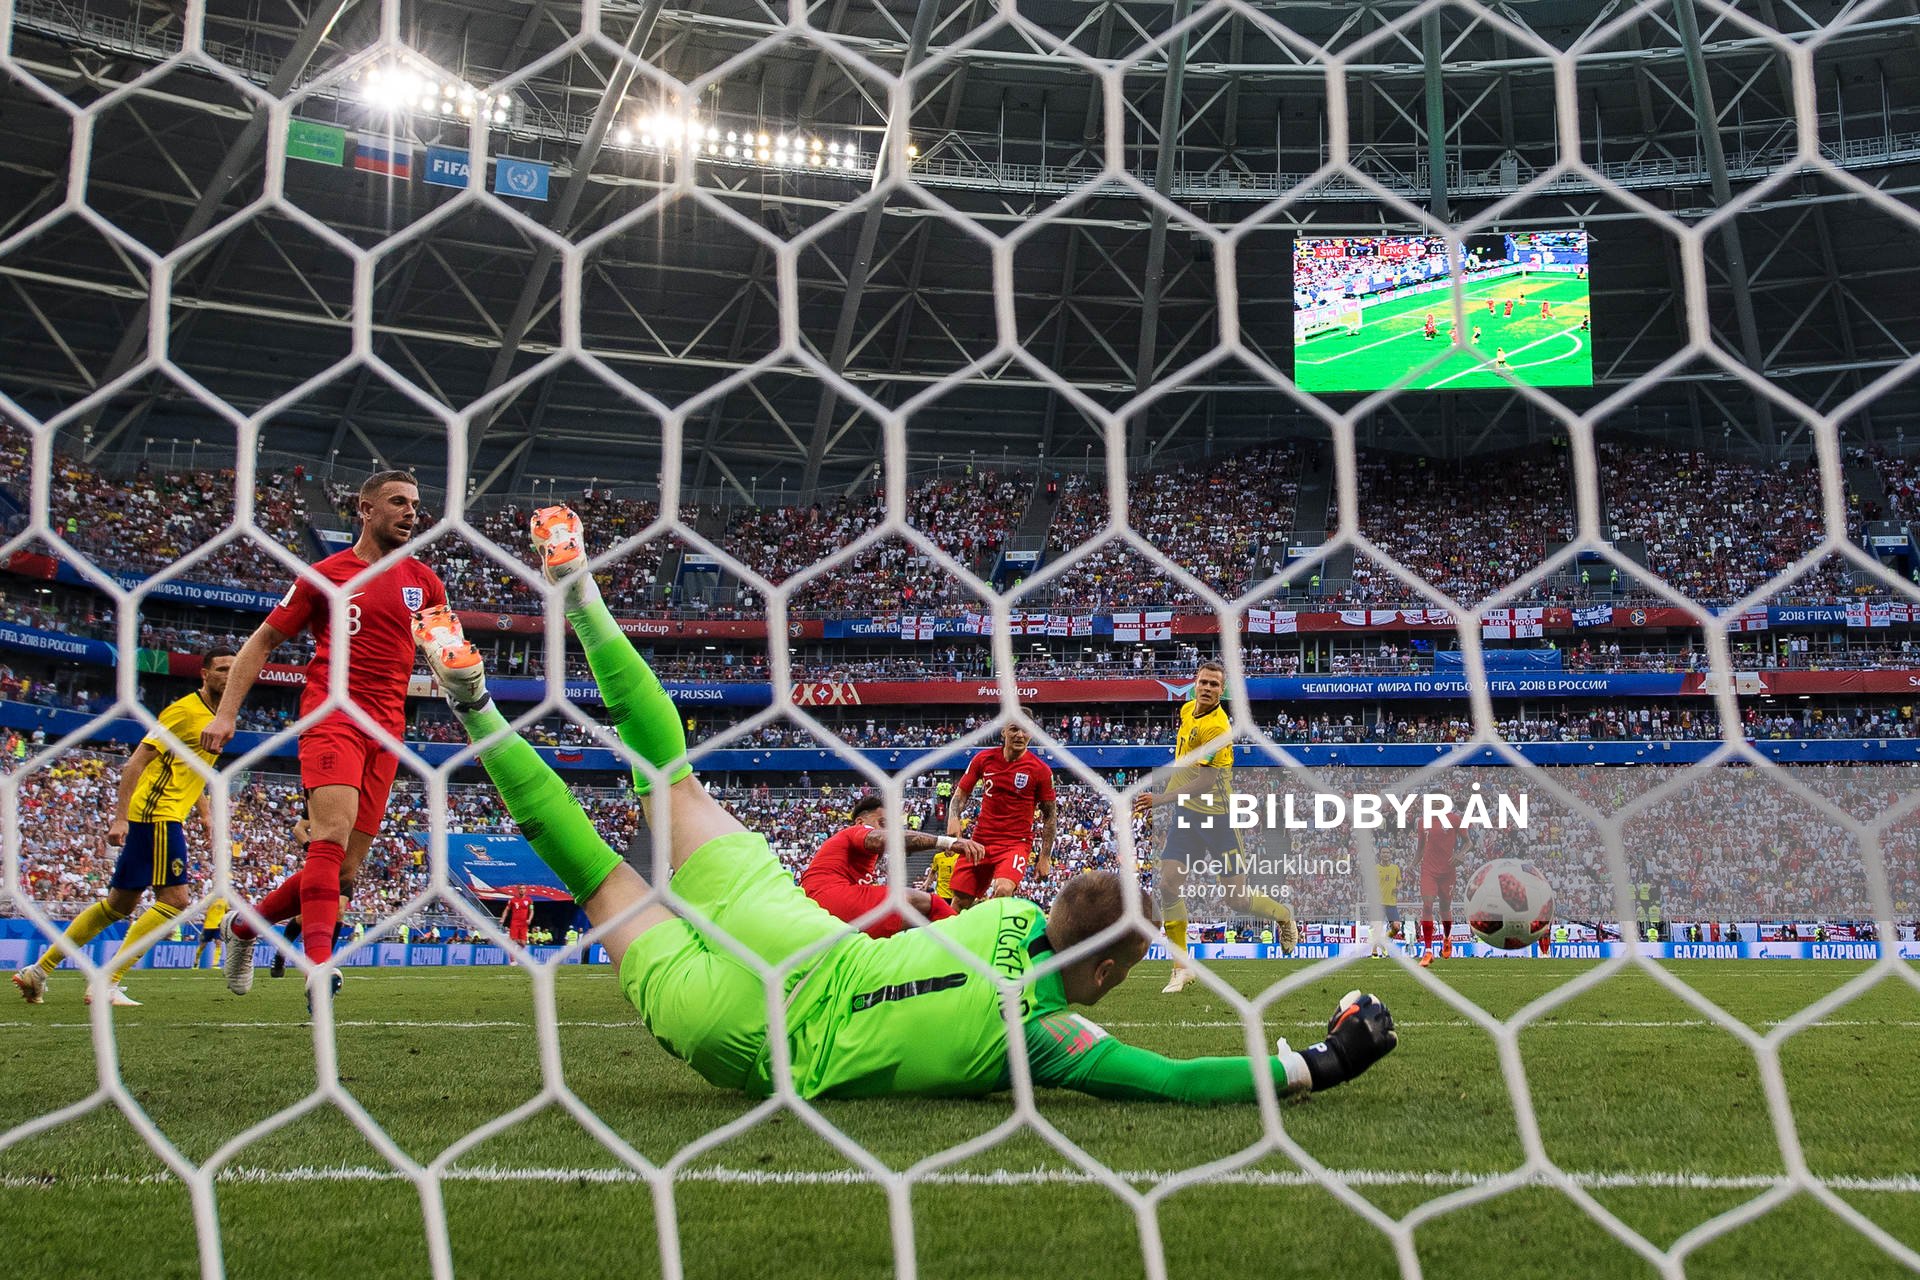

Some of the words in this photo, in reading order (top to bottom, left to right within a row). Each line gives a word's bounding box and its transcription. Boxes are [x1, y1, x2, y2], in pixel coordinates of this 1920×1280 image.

[433, 158, 471, 178] FIFA
[1366, 248, 1374, 256] 2
[1384, 247, 1403, 255] ENG
[1431, 245, 1450, 253] 61:2
[185, 587, 201, 599] ПО
[204, 588, 256, 604] ФУТБОЛУ
[1598, 603, 1607, 611] FC
[1489, 618, 1536, 626] EASTWOOD
[1591, 617, 1610, 625] TOUR
[1778, 611, 1805, 621] 2018
[1807, 611, 1832, 621] FIFA
[0, 628, 18, 643] FIFA
[19, 633, 39, 647] 2018
[48, 639, 87, 655] РОССИИ
[680, 688, 724, 700] RUSSIA
[1302, 682, 1374, 694] ЧЕМПИОНАТ
[1377, 682, 1412, 693] МИРА
[1414, 682, 1431, 692] ПО
[1492, 681, 1516, 691] FIFA
[1519, 681, 1546, 691] 2018
[1548, 681, 1556, 690] В
[1558, 680, 1608, 690] РОССИИ
[1012, 854, 1027, 875] 12
[858, 873, 873, 885] 2
[1324, 936, 1368, 944] COVENTY
[411, 946, 443, 966] GAZPROM
[475, 947, 505, 966] GAZPROM
[1674, 944, 1738, 960] GAZPROM
[1812, 944, 1877, 960] GAZPROM
